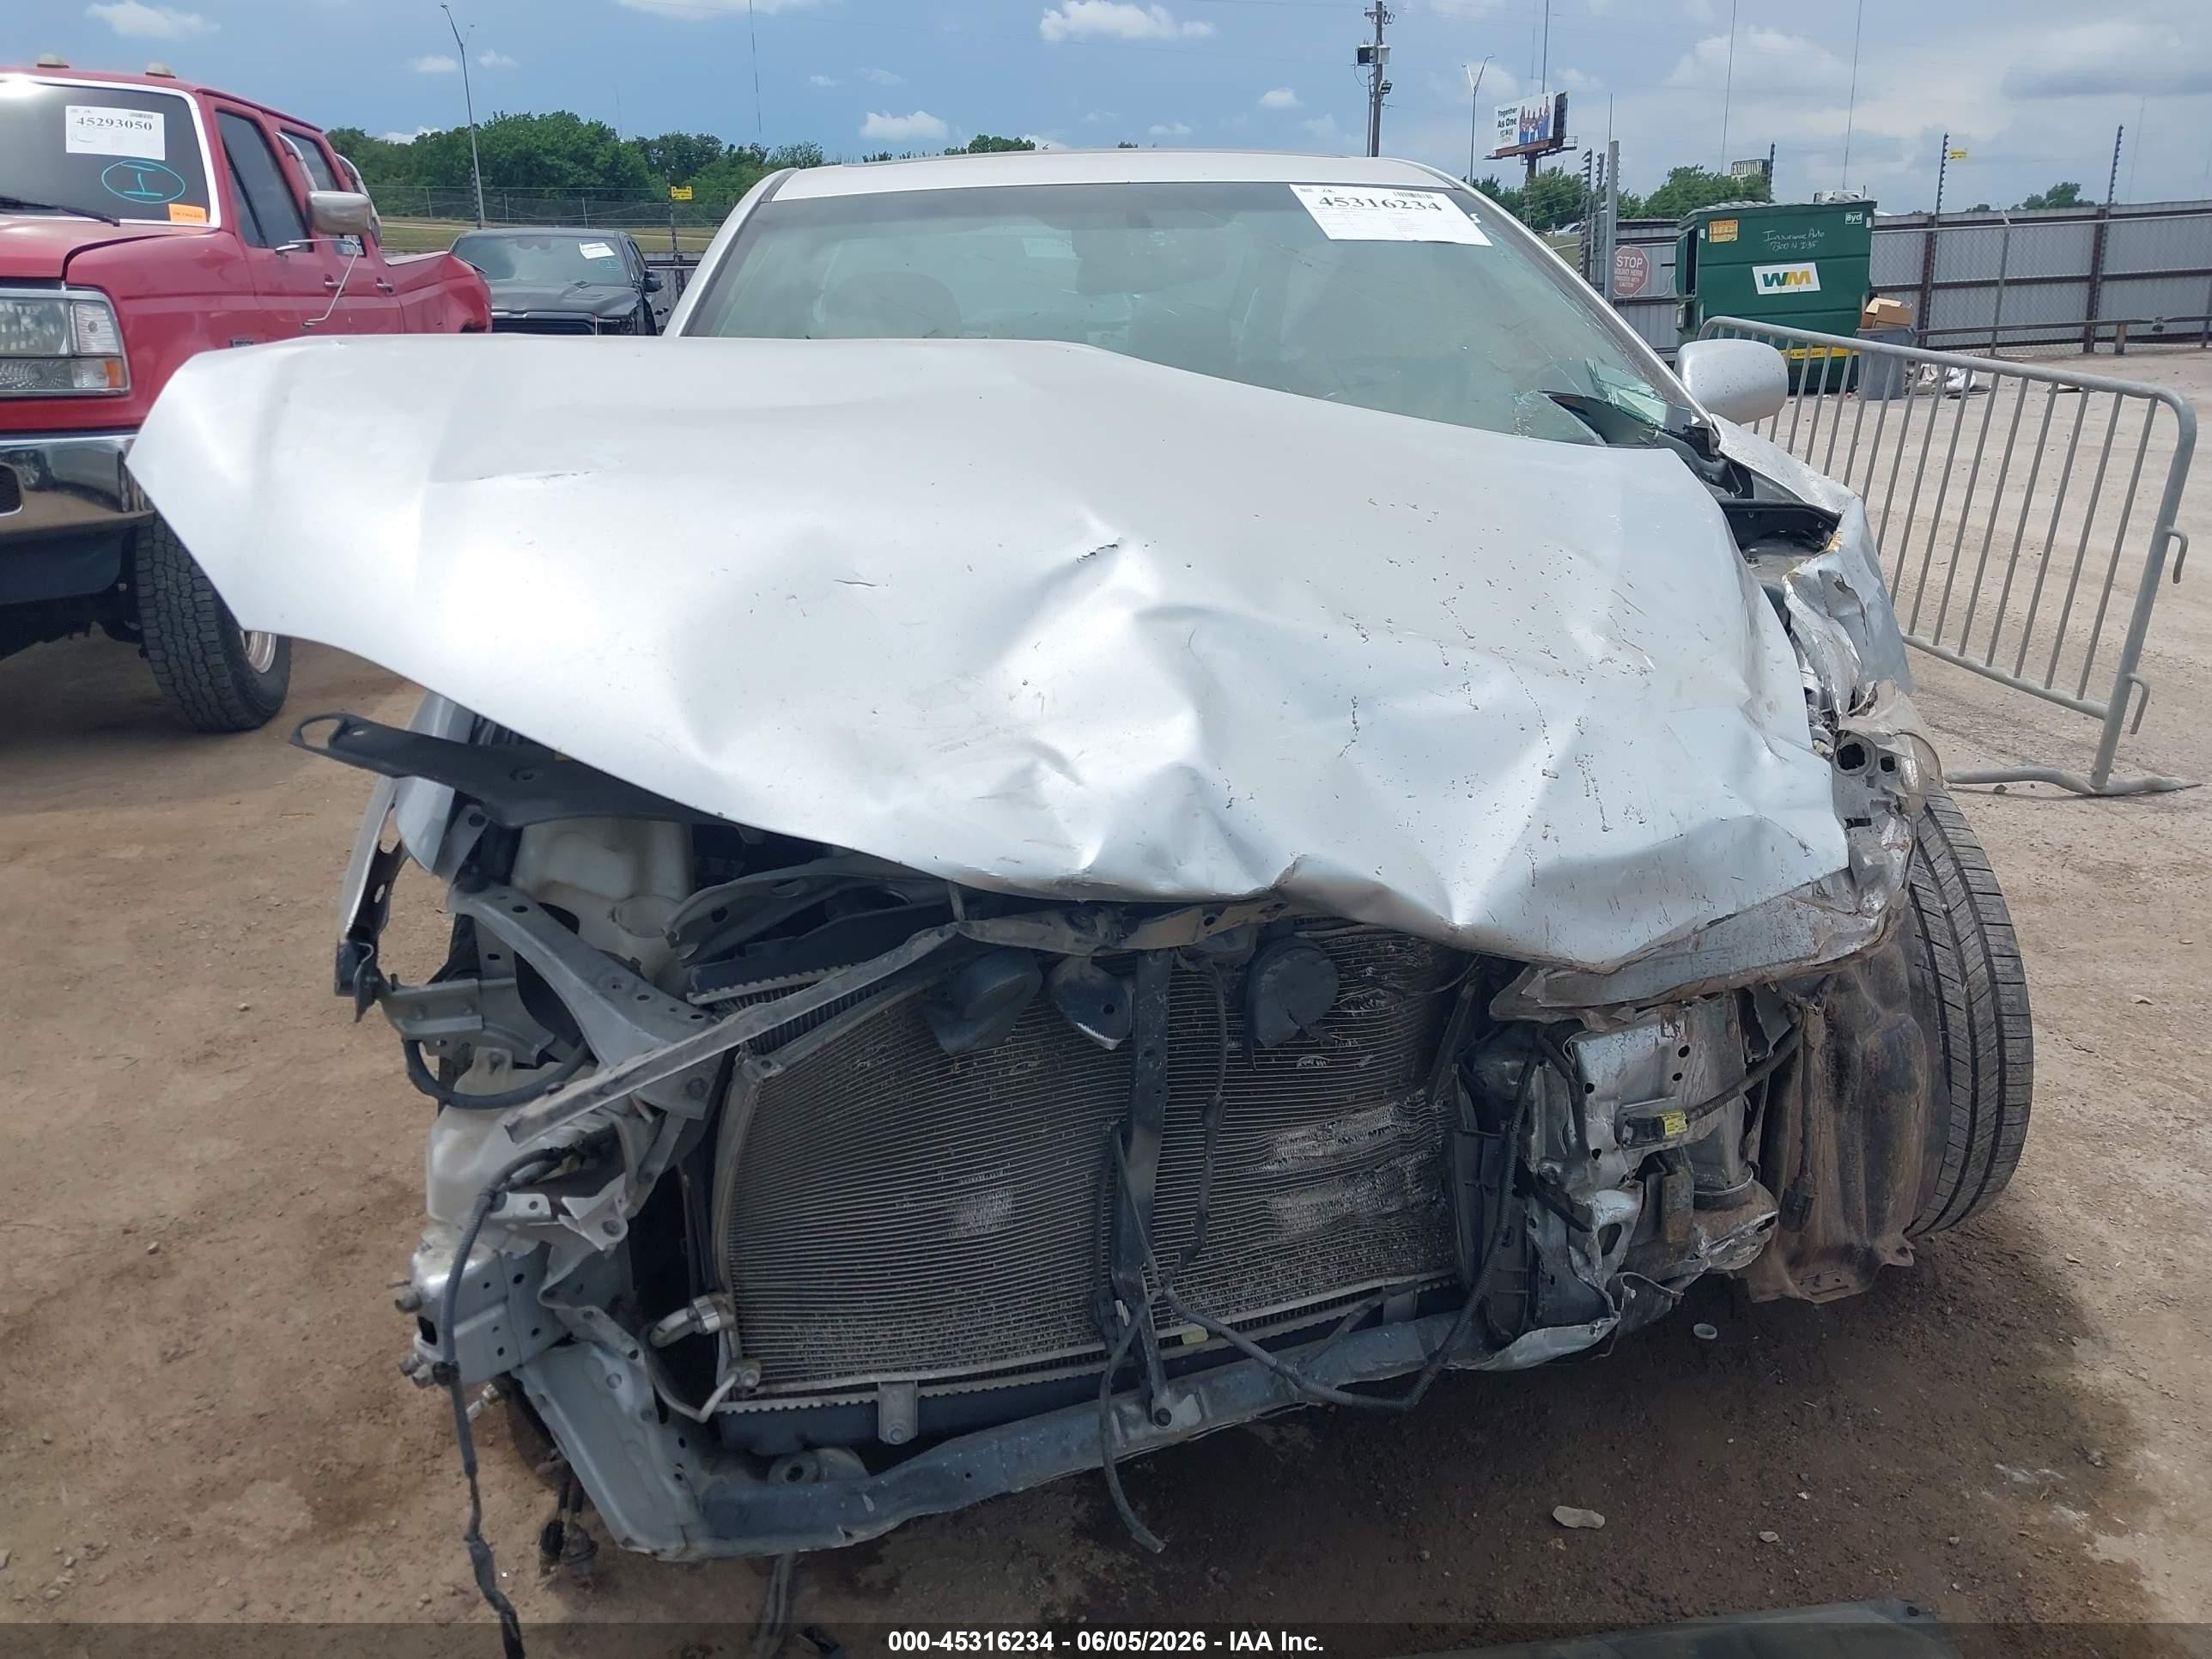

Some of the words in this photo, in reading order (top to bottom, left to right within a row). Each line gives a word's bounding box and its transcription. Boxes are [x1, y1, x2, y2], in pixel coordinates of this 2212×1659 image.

[1498, 106, 1517, 118] Together
[76, 117, 153, 131] 45293050
[1497, 119, 1505, 129] As
[1505, 118, 1517, 127] One
[1319, 196, 1443, 211] 45316234
[1808, 227, 1826, 239] Auto
[1616, 256, 1643, 269] STOP
[1762, 270, 1812, 288] WM
